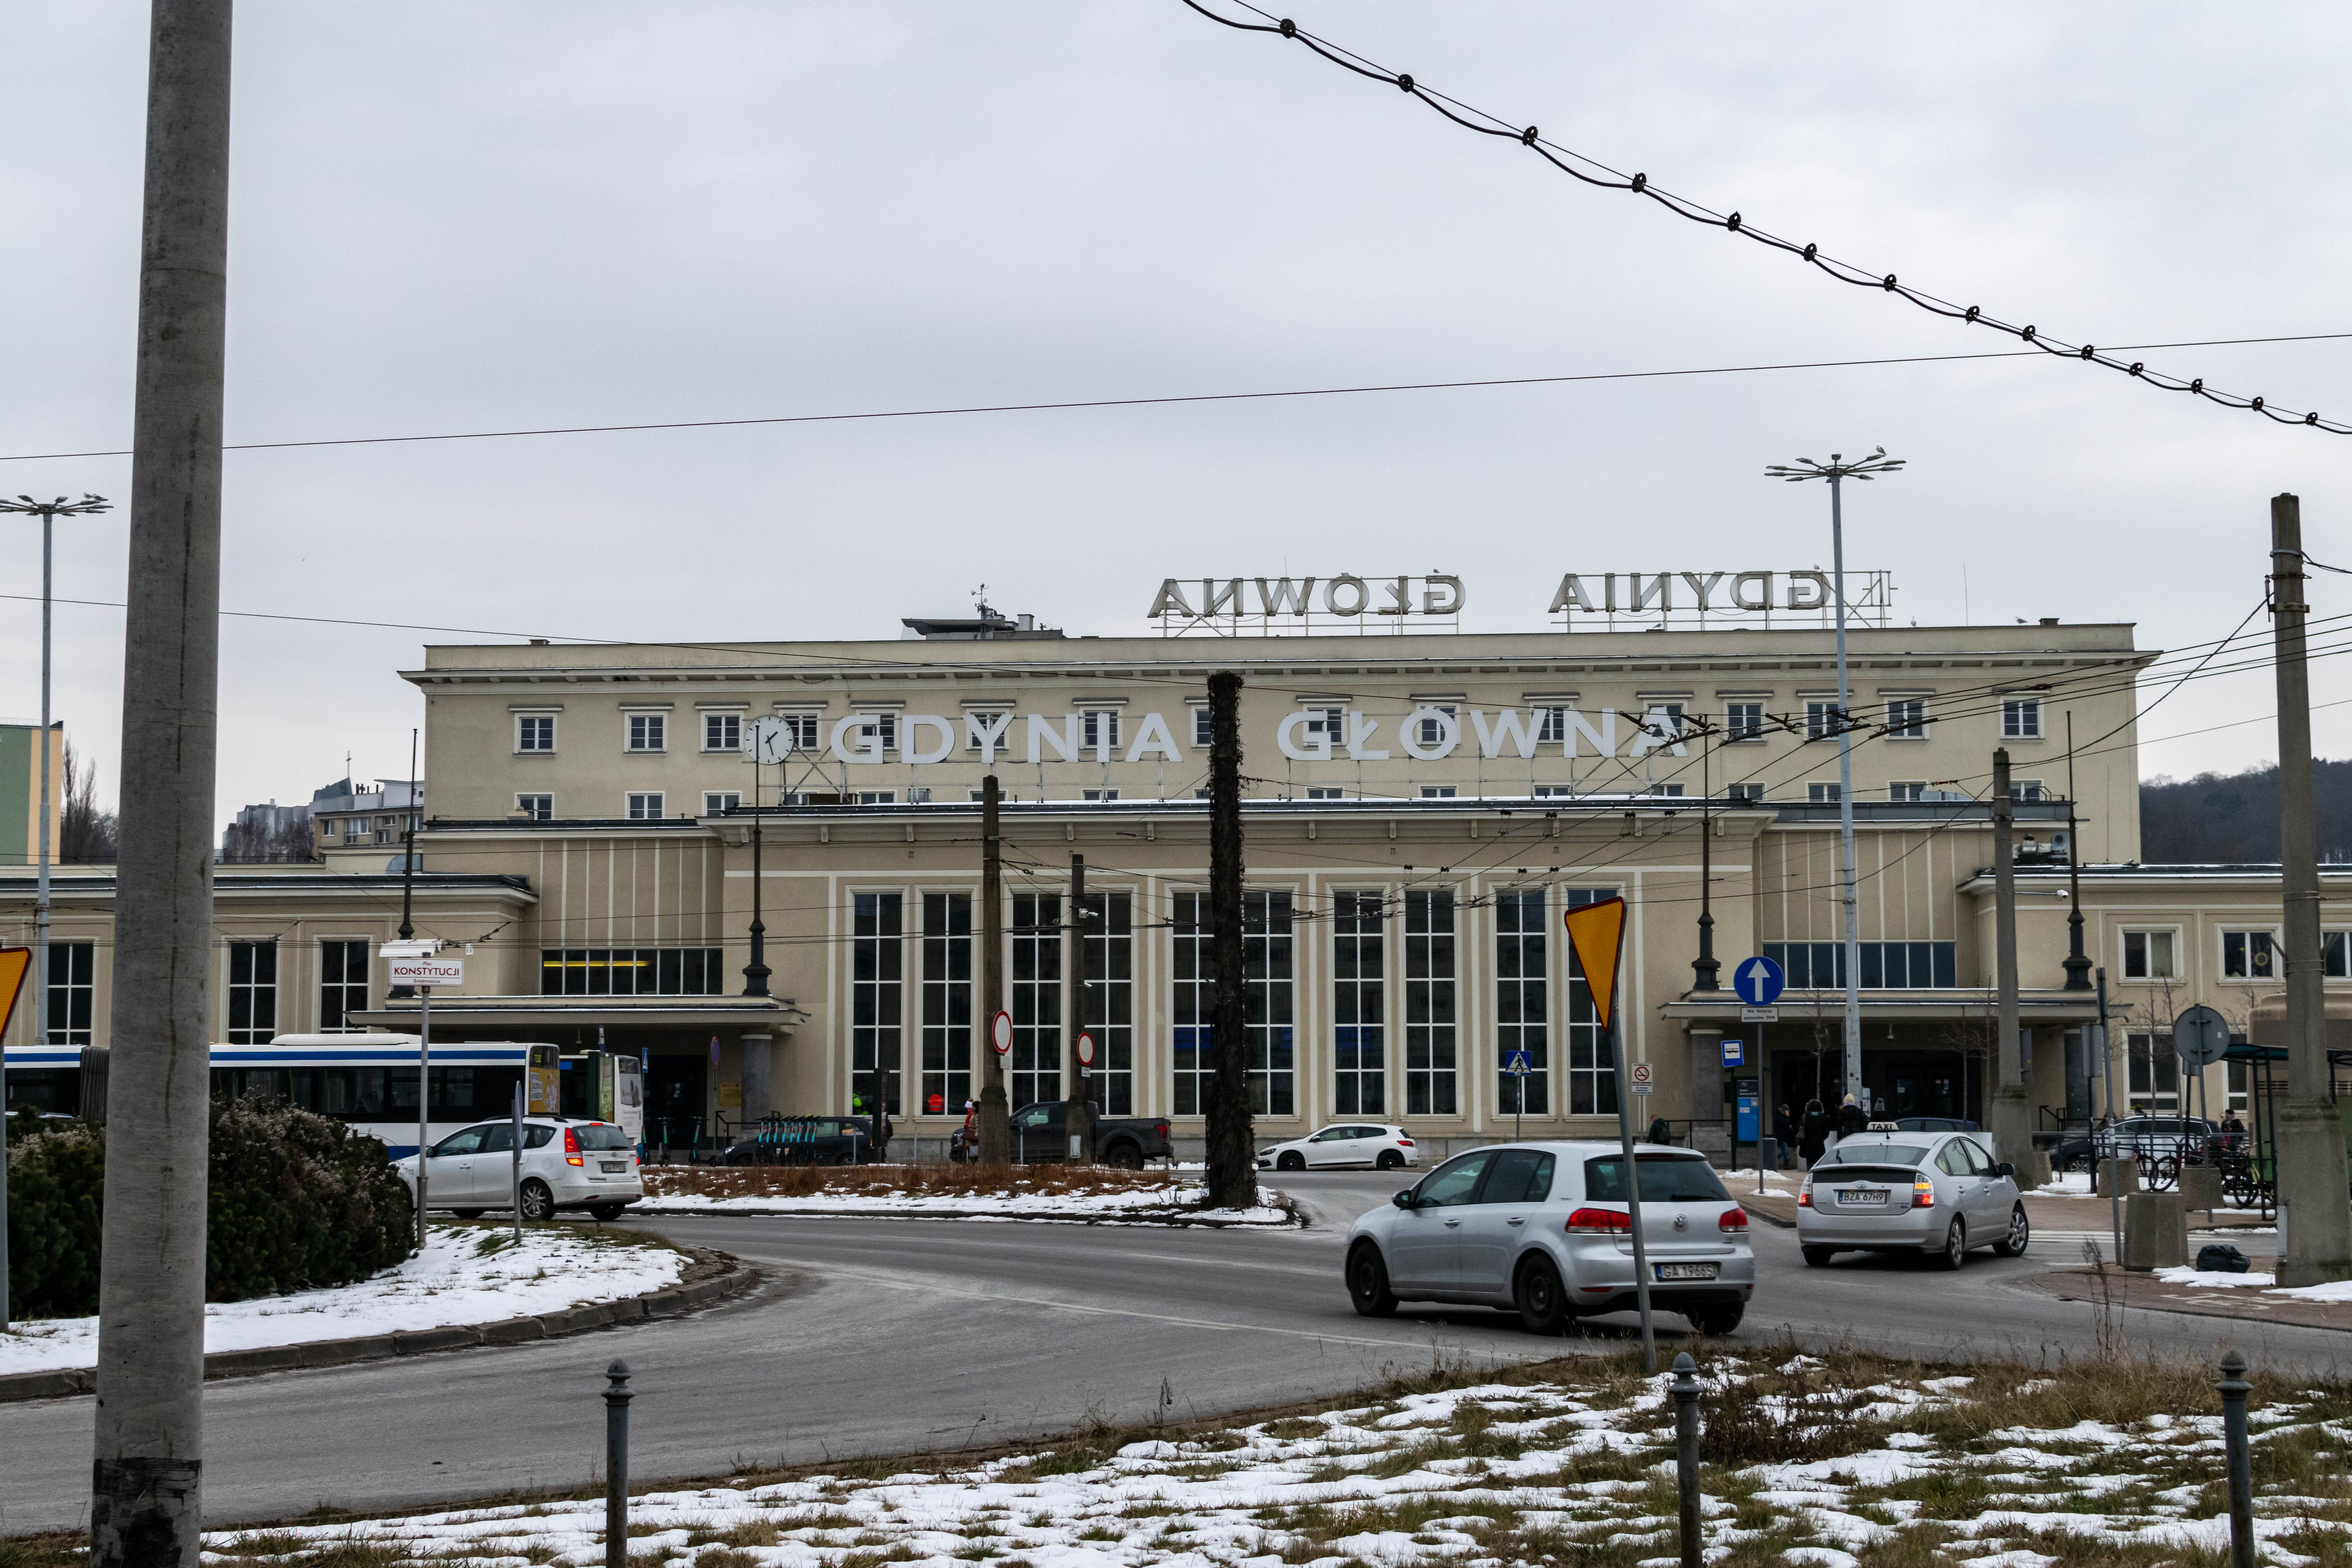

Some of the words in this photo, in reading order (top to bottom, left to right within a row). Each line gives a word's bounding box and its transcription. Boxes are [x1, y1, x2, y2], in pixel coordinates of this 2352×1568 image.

[830, 713, 1184, 764] GDYNIA
[1277, 705, 1689, 761] GŁÓWNA
[394, 967, 459, 976] KONSTYTUCJI
[1844, 1193, 1860, 1201] BZA
[1863, 1193, 1884, 1201] 67H9
[1663, 1265, 1679, 1278] GA
